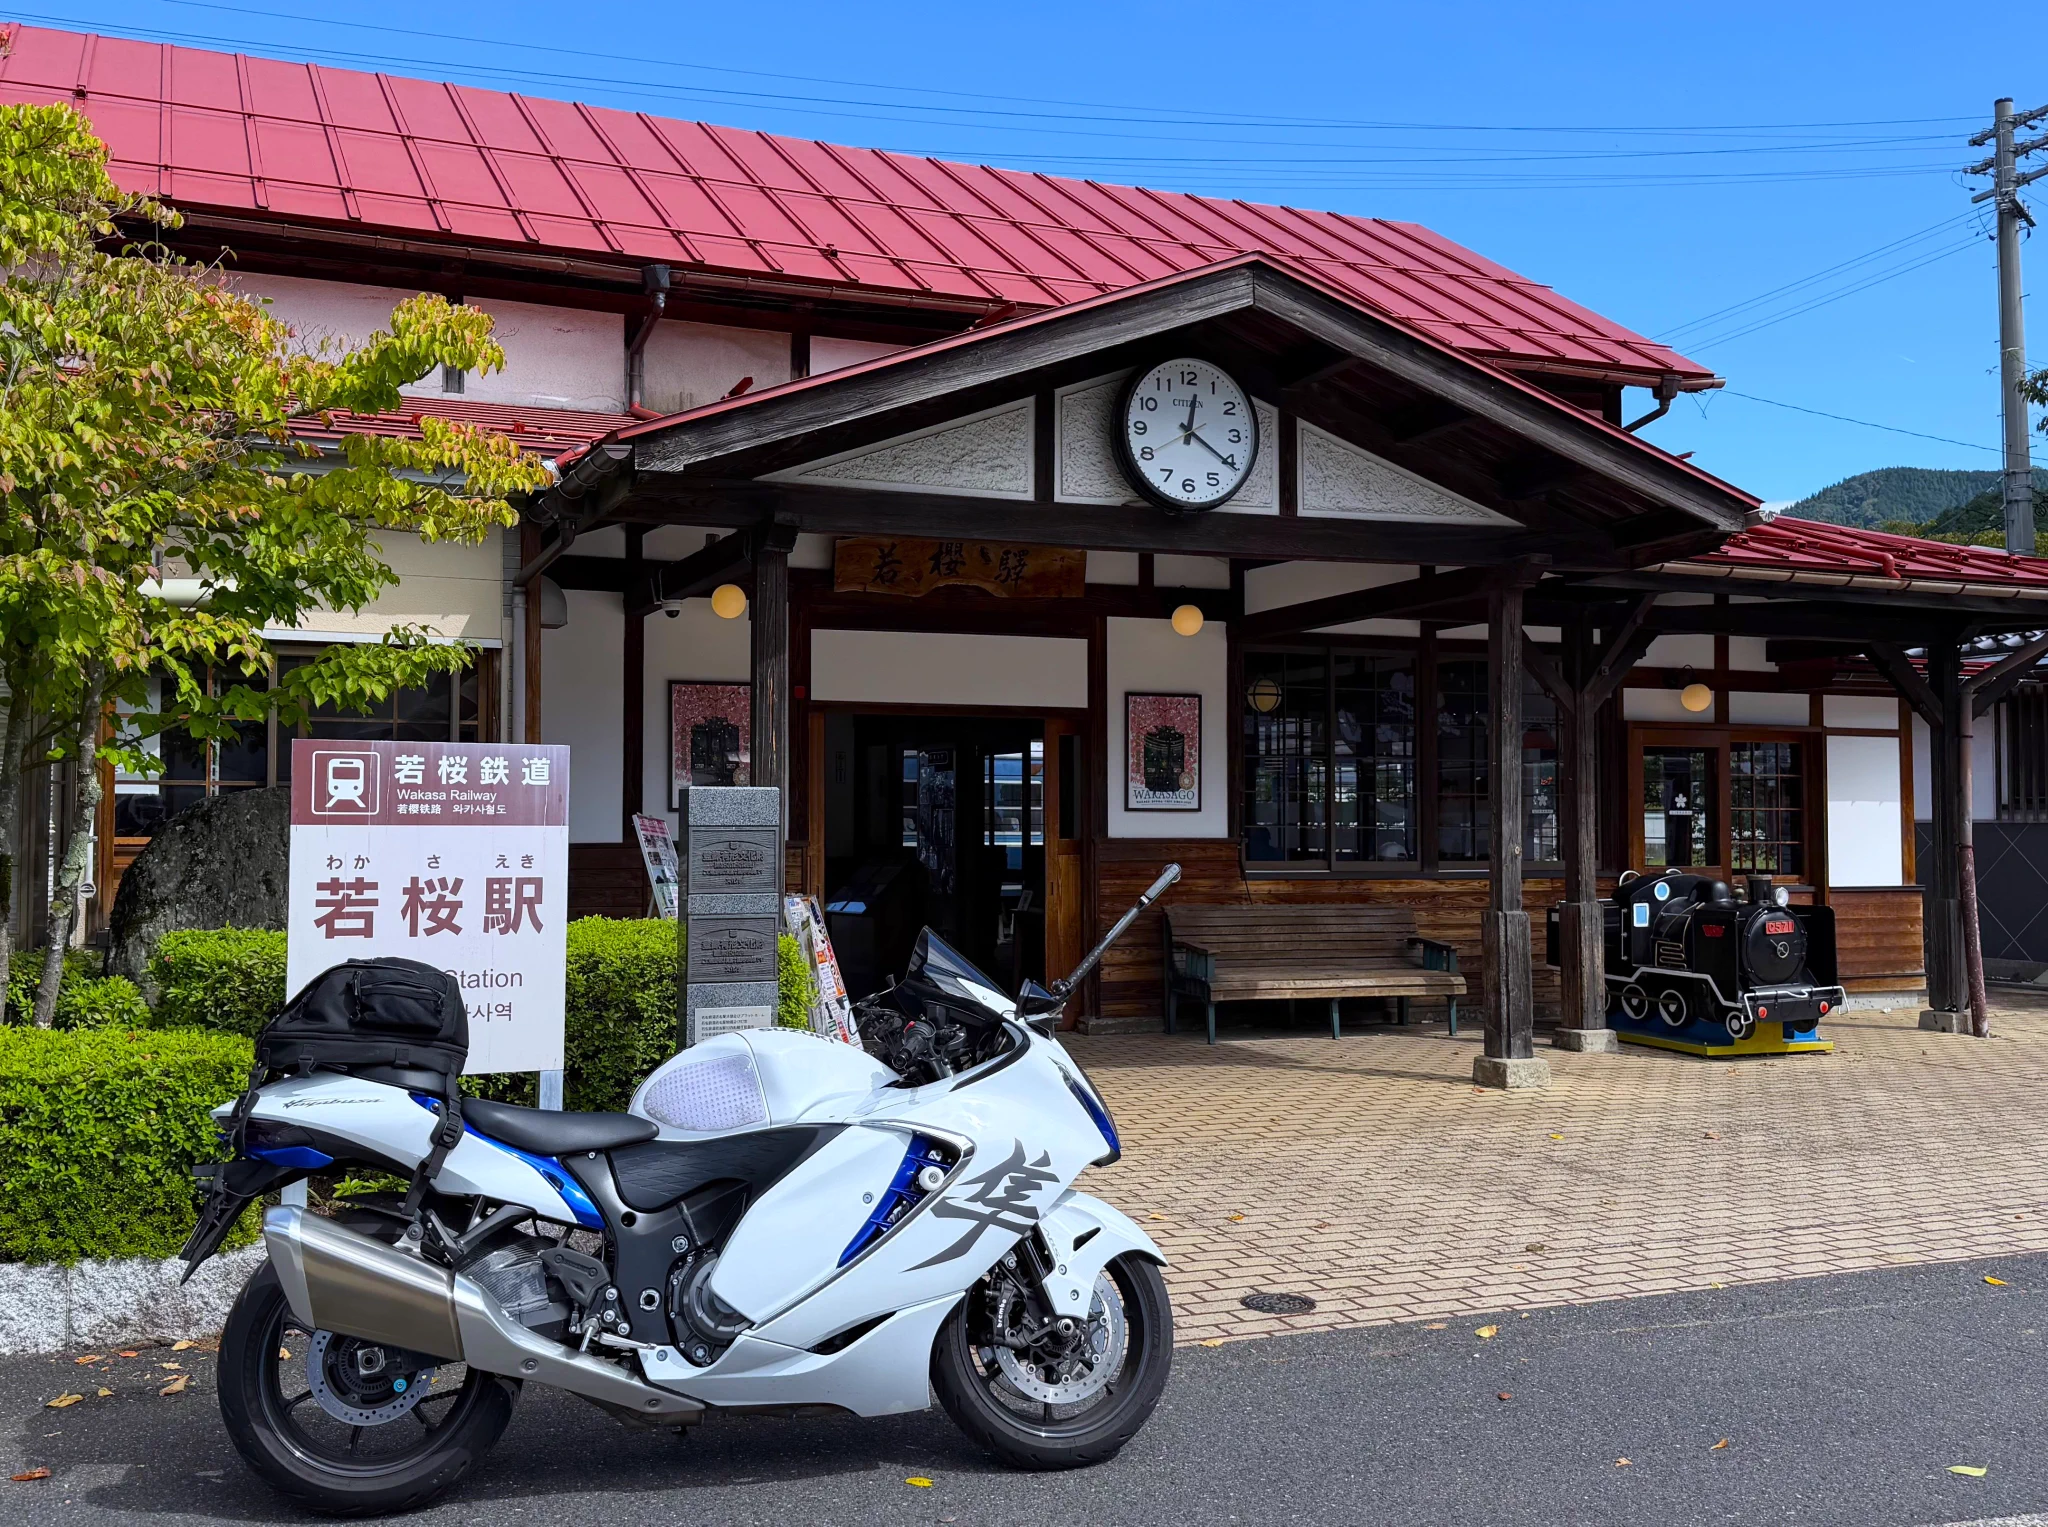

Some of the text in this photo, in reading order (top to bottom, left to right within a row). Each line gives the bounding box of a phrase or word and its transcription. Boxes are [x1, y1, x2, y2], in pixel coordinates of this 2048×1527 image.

[1156, 377, 1172, 392] 11
[1180, 371, 1198, 386] 12
[1211, 381, 1216, 395] 1
[1140, 397, 1158, 412] 10
[1223, 401, 1236, 416] 2
[1133, 420, 1148, 436] 9
[1228, 429, 1242, 444] 3
[1140, 446, 1155, 461] 8
[1160, 468, 1174, 483] 7
[1206, 472, 1220, 487] 5
[1181, 478, 1196, 493] 6
[394, 754, 551, 786] 若桜鉄道
[396, 788, 498, 804] Wakasa Railway
[452, 803, 507, 815] 와카사철도
[326, 854, 535, 870] わか さ えき
[313, 876, 545, 940] 若桜駅
[899, 1137, 1061, 1273] 隼
[996, 1298, 1007, 1328] brembo
